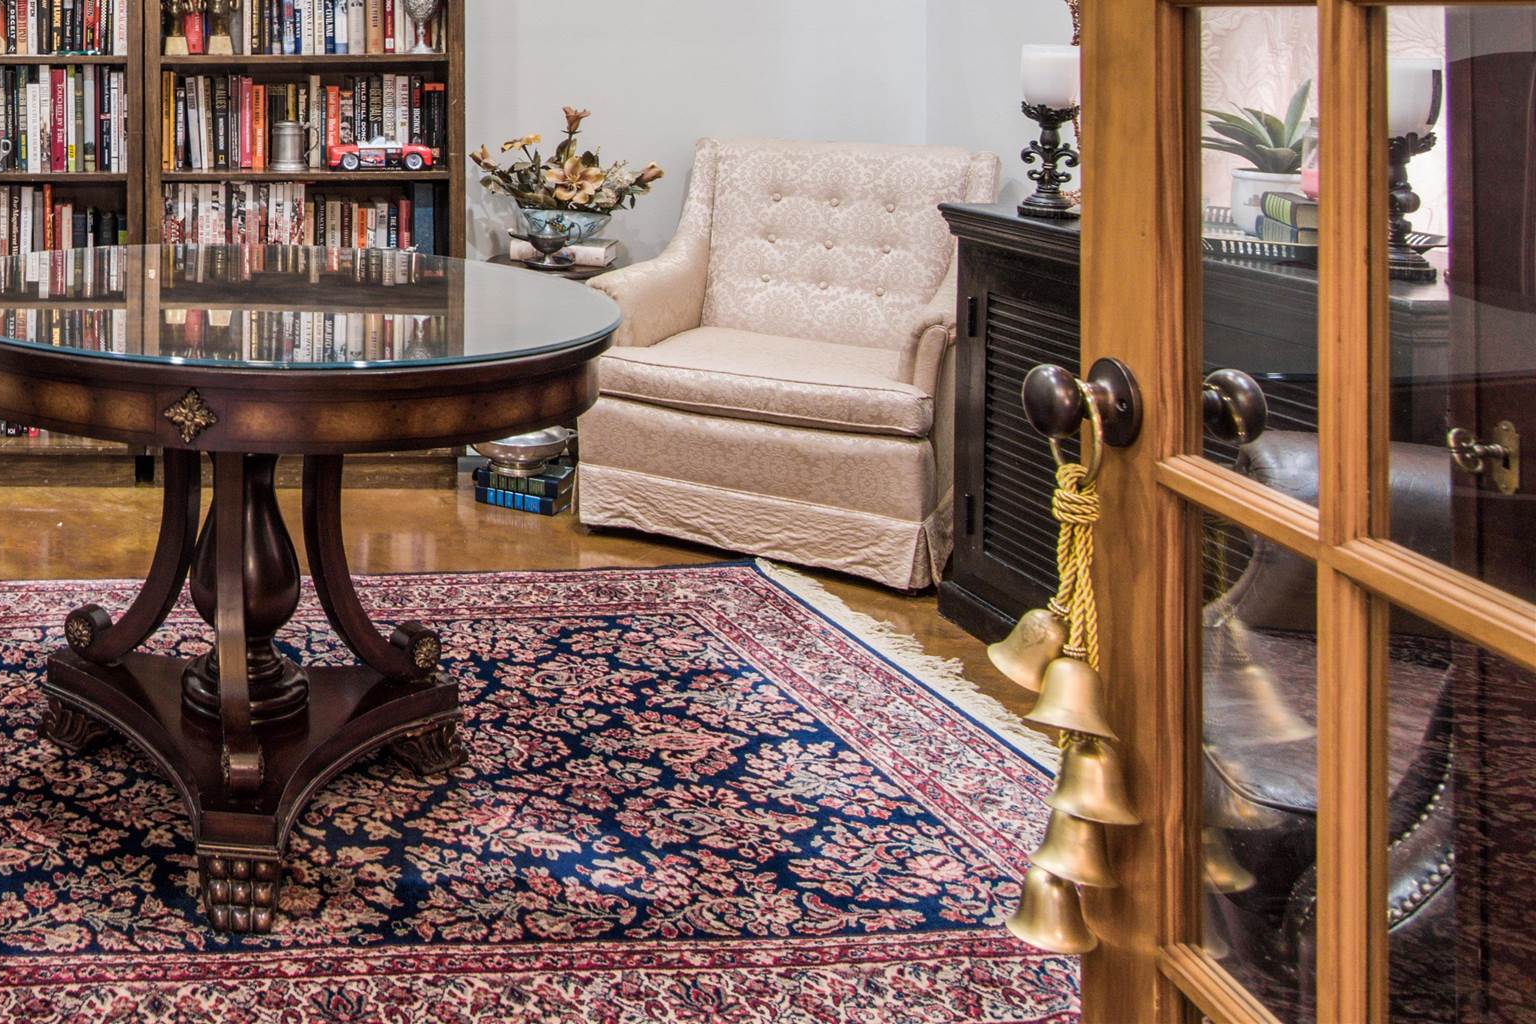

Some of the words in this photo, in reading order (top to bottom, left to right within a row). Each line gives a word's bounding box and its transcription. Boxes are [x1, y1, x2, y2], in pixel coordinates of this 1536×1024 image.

[216, 90, 226, 108] ALLIES
[370, 89, 381, 121] GENERALS
[57, 118, 64, 126] BY
